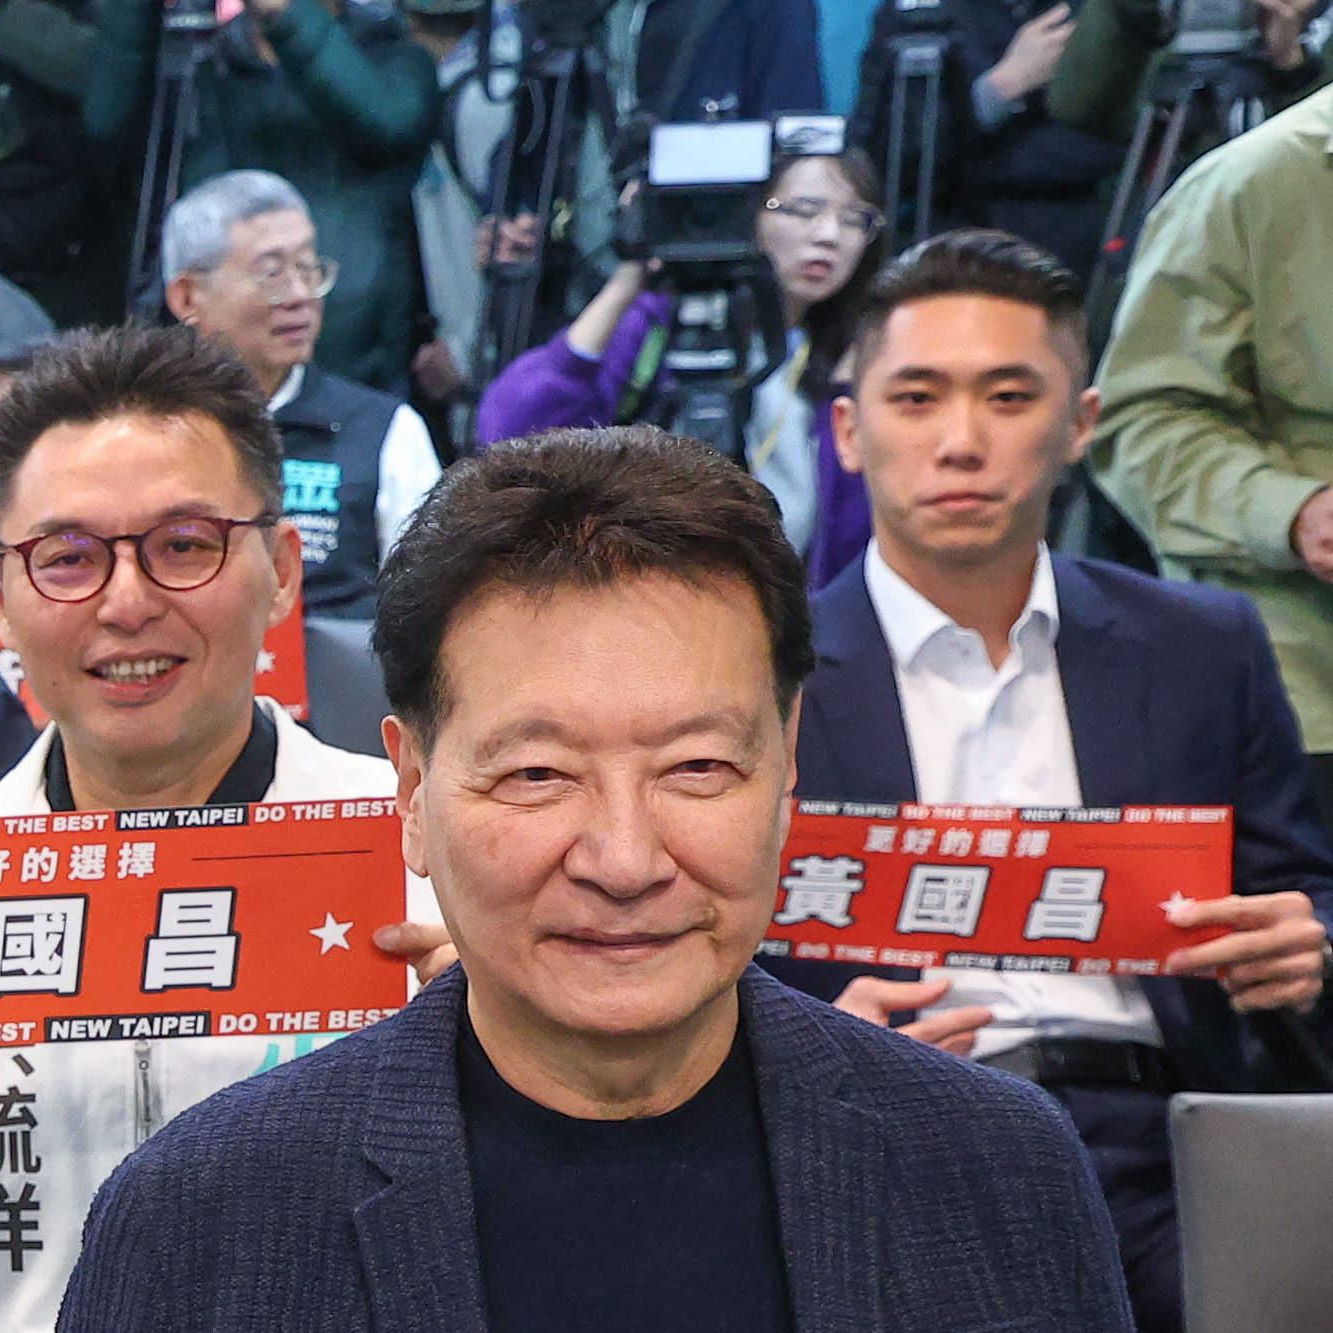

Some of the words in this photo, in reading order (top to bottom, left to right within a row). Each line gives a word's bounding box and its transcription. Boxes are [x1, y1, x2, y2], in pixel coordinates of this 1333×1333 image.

[4, 817, 47, 834] THE
[52, 815, 109, 832] BEST
[120, 811, 170, 829] NEW
[174, 807, 244, 826] TAIPEI
[255, 806, 286, 822] DO
[292, 803, 335, 820] THE
[341, 799, 398, 818] BEST
[773, 855, 1106, 942] 黃國昌
[50, 1019, 112, 1040] NEW
[118, 1015, 205, 1037] TAIPEI
[219, 1014, 257, 1033] DO
[266, 1011, 320, 1031] THE
